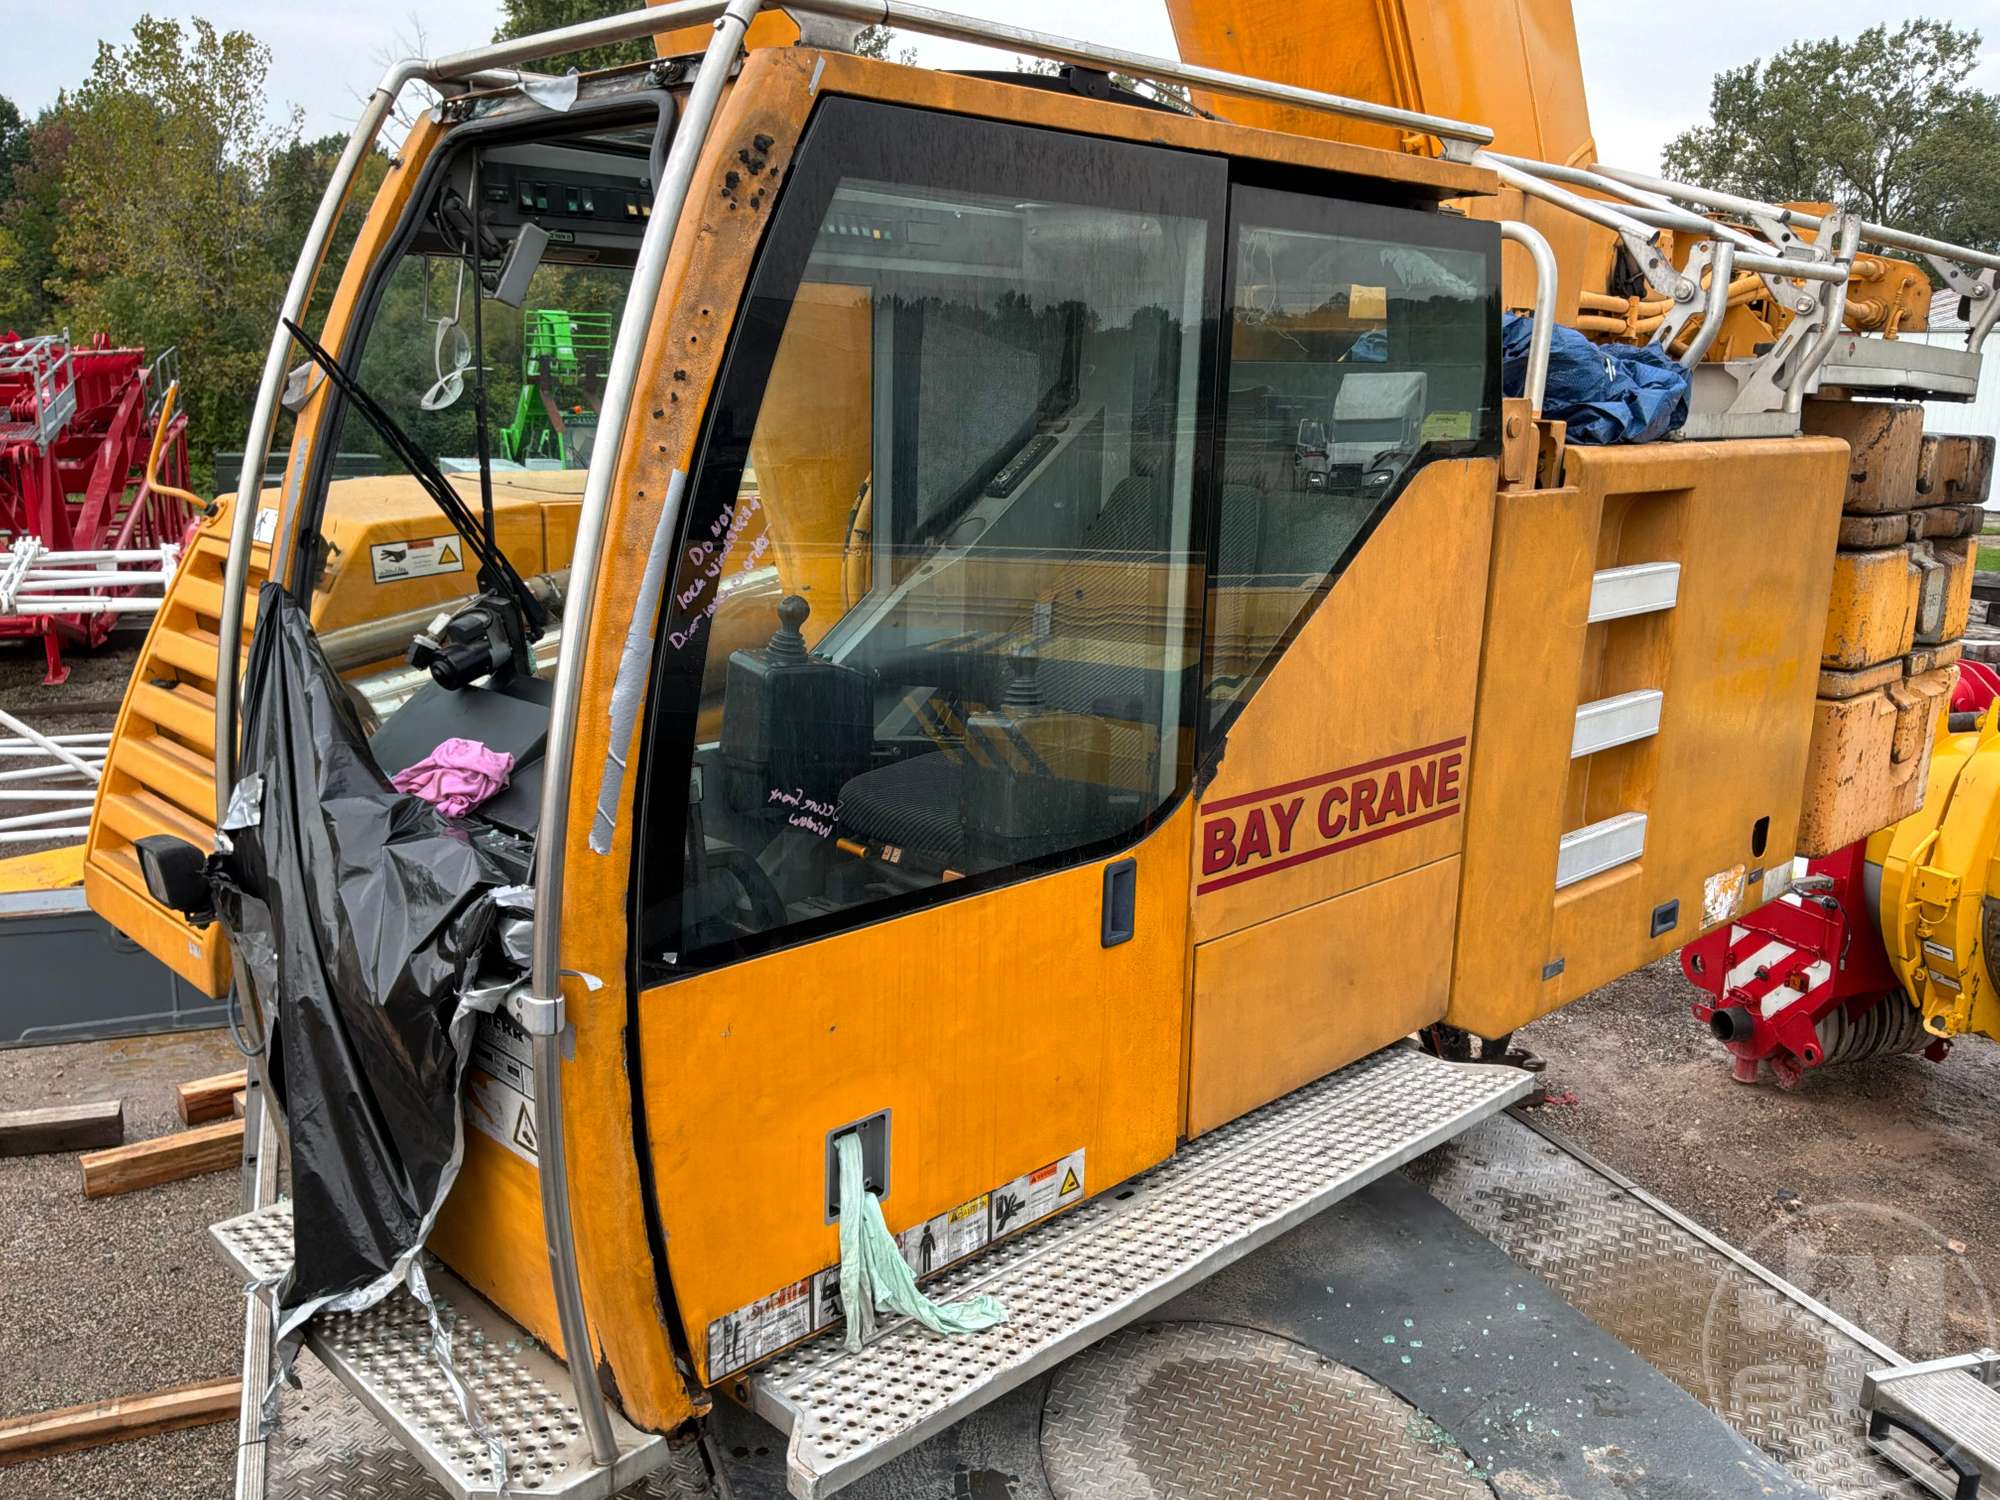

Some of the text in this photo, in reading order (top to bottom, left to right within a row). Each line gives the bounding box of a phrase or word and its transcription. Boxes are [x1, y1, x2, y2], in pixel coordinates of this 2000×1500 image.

[689, 541, 713, 566] Do
[677, 578, 706, 609] lock
[1202, 753, 1462, 876] BAY CRANE
